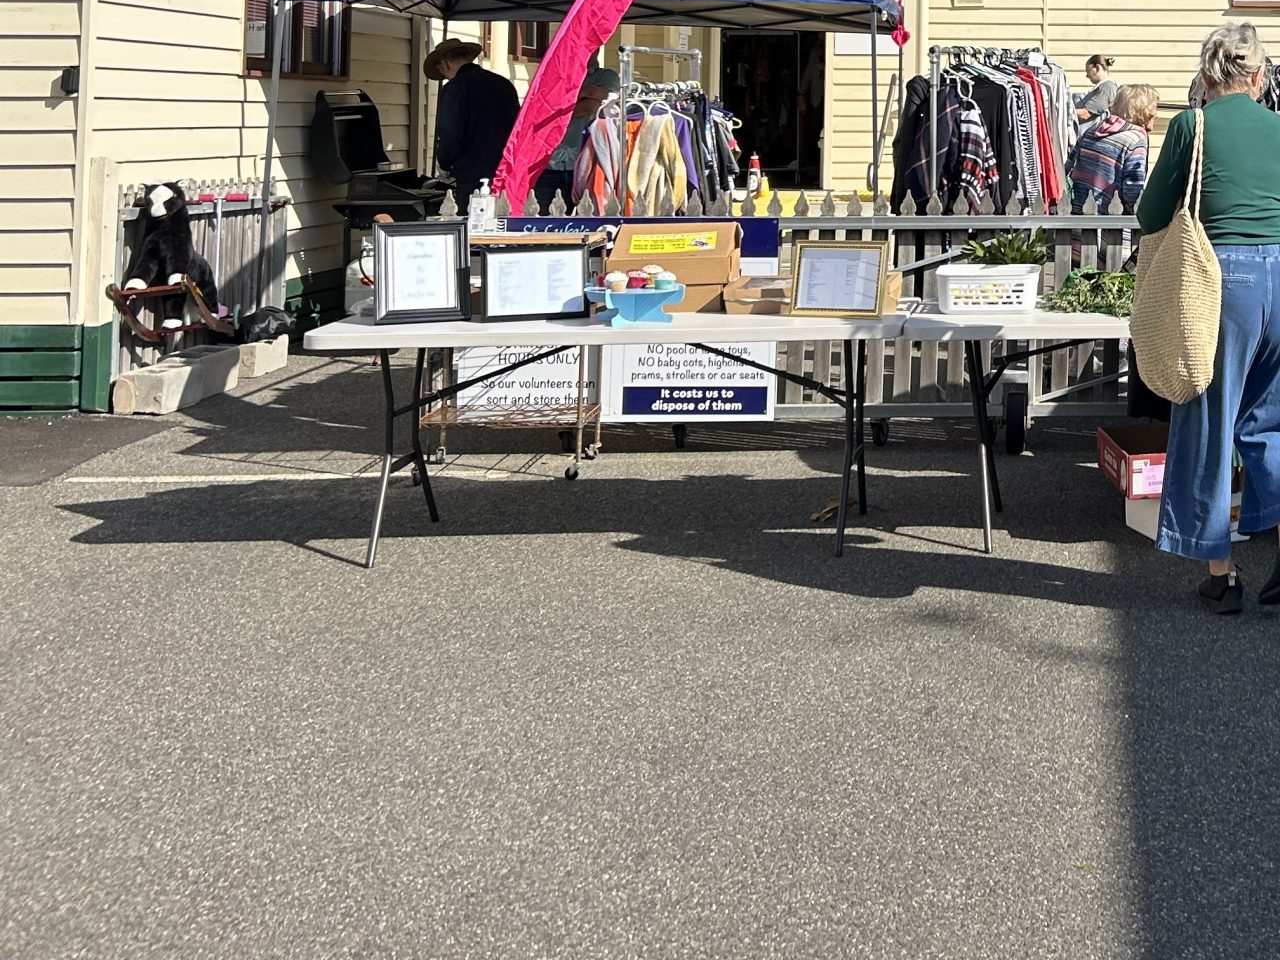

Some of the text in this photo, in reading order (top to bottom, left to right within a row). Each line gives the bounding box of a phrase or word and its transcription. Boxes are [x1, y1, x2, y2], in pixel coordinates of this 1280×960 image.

[647, 344, 664, 354] NO
[667, 343, 687, 357] pool
[547, 352, 580, 365] ONLY
[638, 357, 655, 367] NO
[657, 357, 681, 369] baby
[683, 358, 706, 369] cots,
[631, 370, 765, 382] prams, strollers or car seats
[481, 379, 496, 389] So
[498, 380, 516, 389] our
[519, 376, 573, 389] volunteers
[486, 394, 508, 405] sort
[511, 393, 531, 405] and
[533, 394, 561, 405] store
[661, 388, 735, 399] It costs us to
[651, 400, 742, 413] dispose of them
